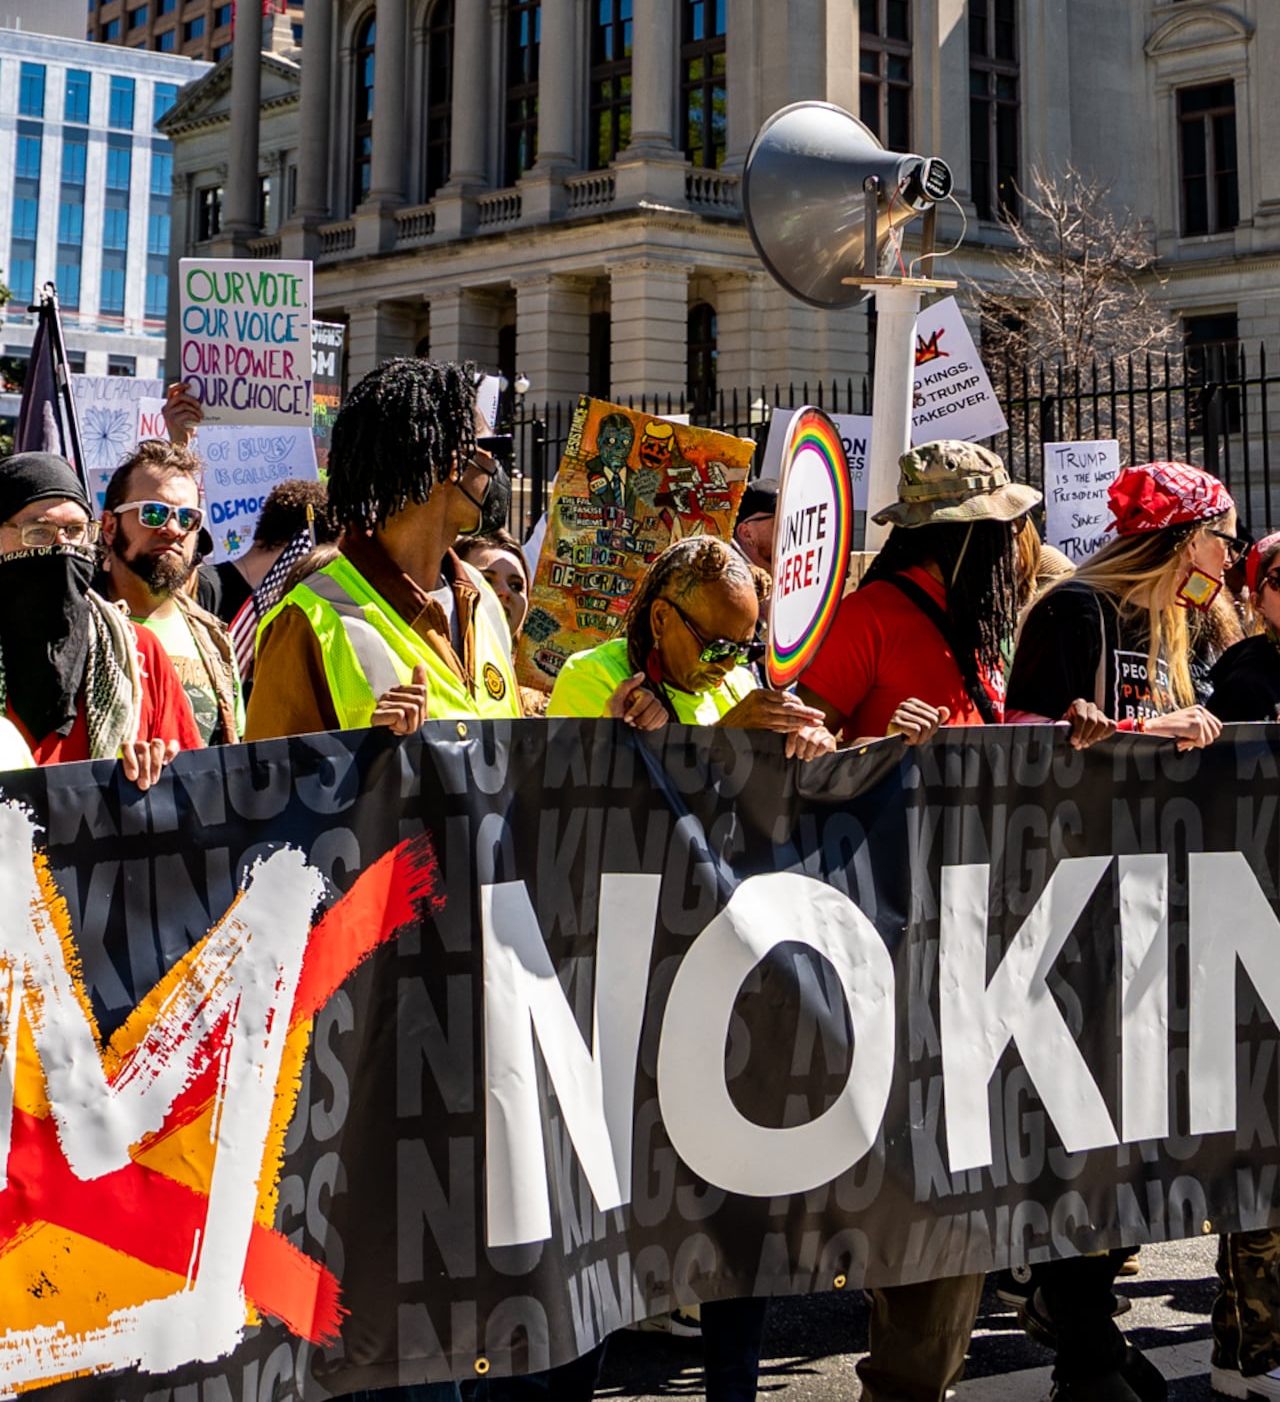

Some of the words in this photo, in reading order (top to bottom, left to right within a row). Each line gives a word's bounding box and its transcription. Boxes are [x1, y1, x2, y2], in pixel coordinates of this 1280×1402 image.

[186, 268, 245, 306] OUR
[245, 271, 308, 309] VOTE,
[183, 304, 229, 340] OUR
[182, 339, 221, 376] OUR
[224, 345, 303, 382] POWER,
[924, 361, 973, 386] KINGS.
[184, 373, 237, 409] OUR
[236, 376, 312, 418] CHOICE!
[928, 375, 981, 405] TRUMP
[140, 412, 168, 437] NO
[911, 391, 991, 428] TAKEOVER.
[207, 439, 230, 462] OF
[1055, 448, 1108, 471] TRUMP
[1055, 473, 1069, 485] IS
[1074, 473, 1090, 484] THE
[781, 502, 829, 556] UNITE
[1071, 513, 1103, 530] SINCE
[1059, 535, 1112, 560] TRUMP
[776, 545, 824, 603] HERE!
[481, 870, 896, 1248] NO
